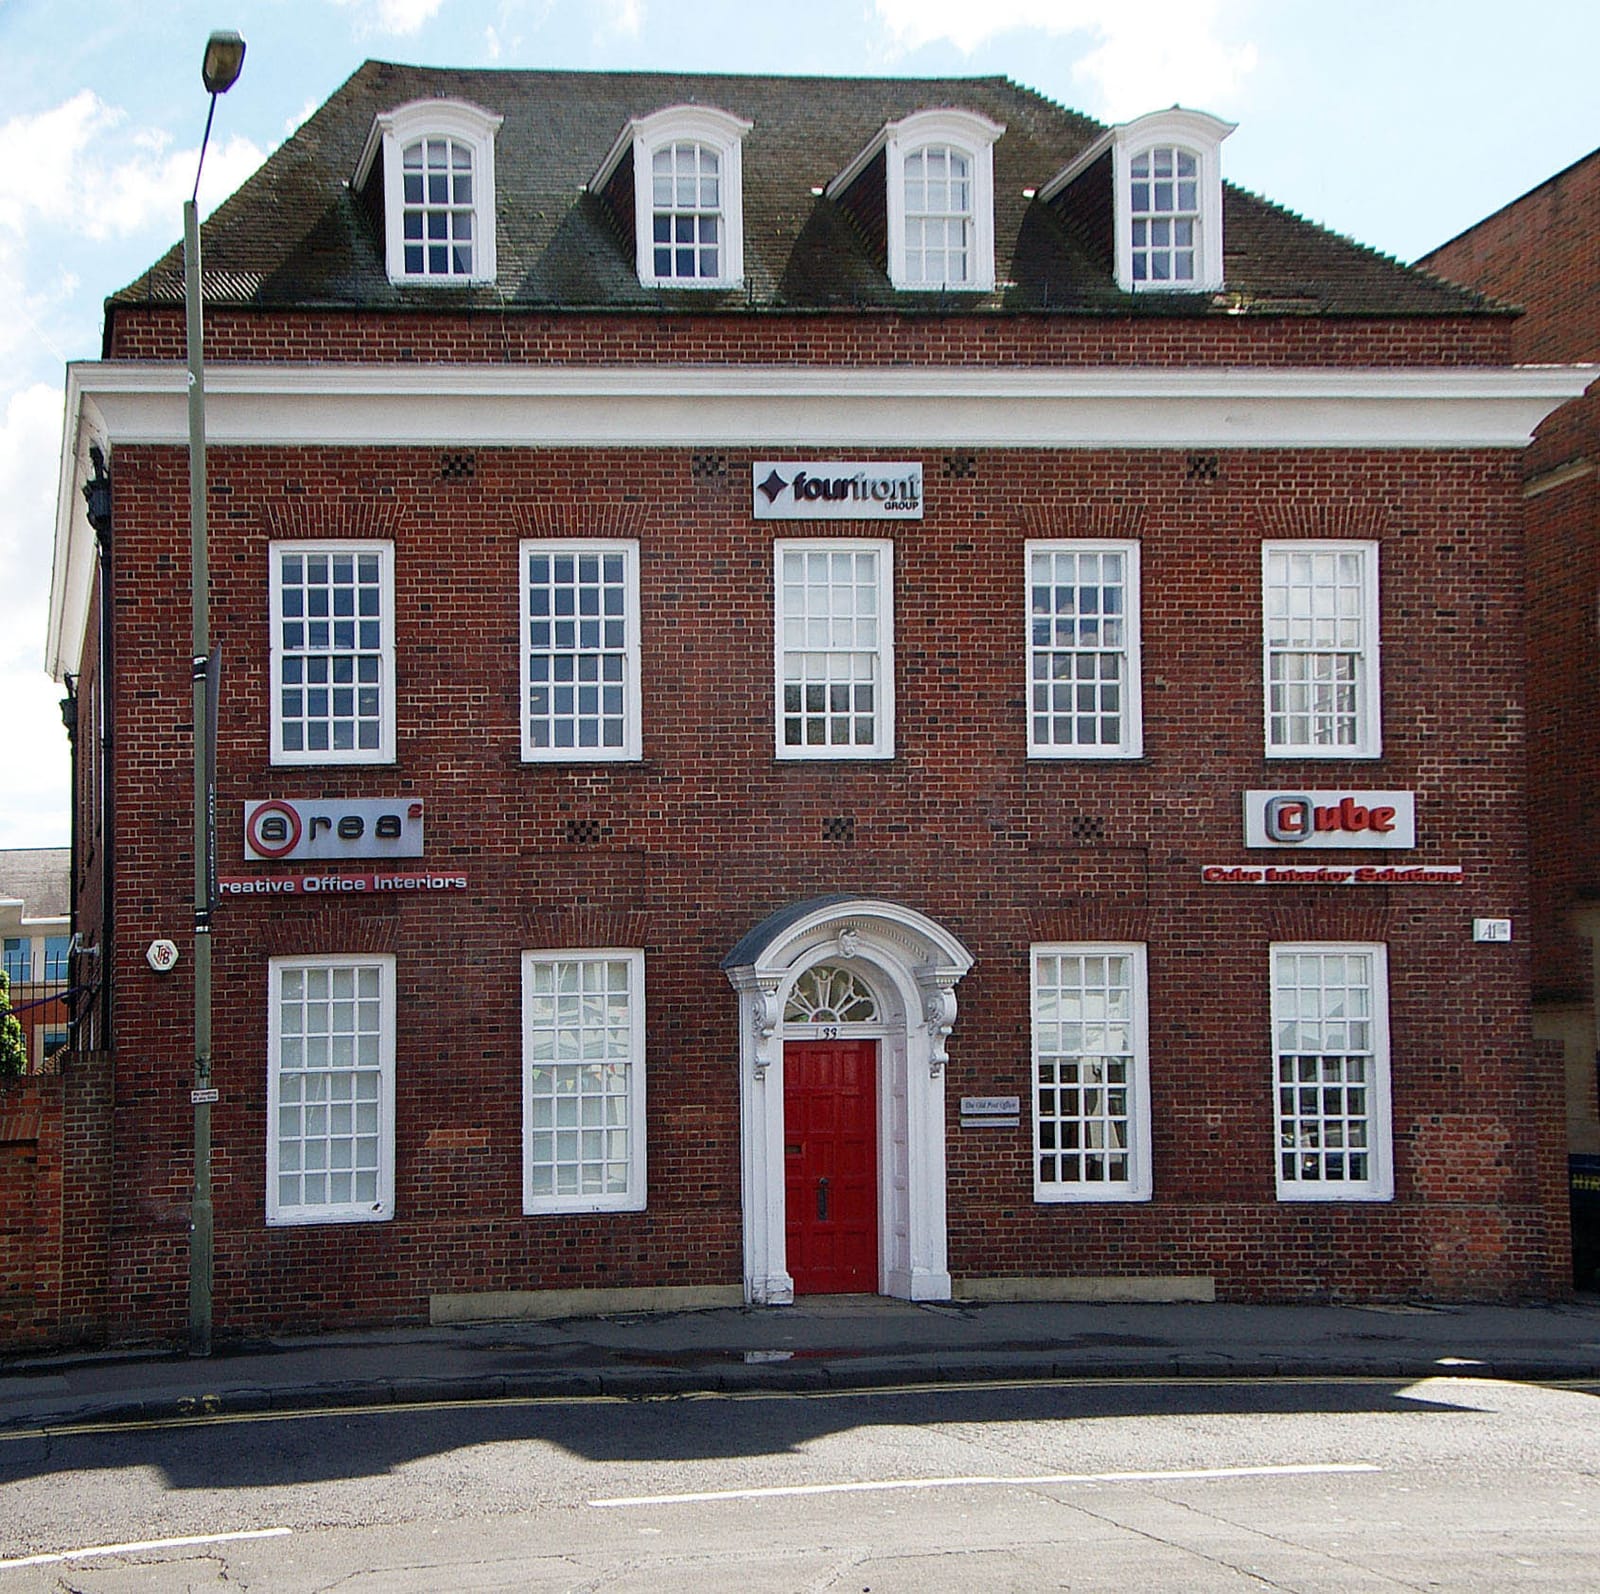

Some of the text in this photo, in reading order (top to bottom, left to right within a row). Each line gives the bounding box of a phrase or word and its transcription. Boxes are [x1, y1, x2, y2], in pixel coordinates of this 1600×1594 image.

[792, 471, 920, 501] fourfront
[884, 501, 919, 511] GROUP
[1204, 867, 1465, 882] Cube Interior Solutions
[219, 874, 467, 894] reative Office Interiors
